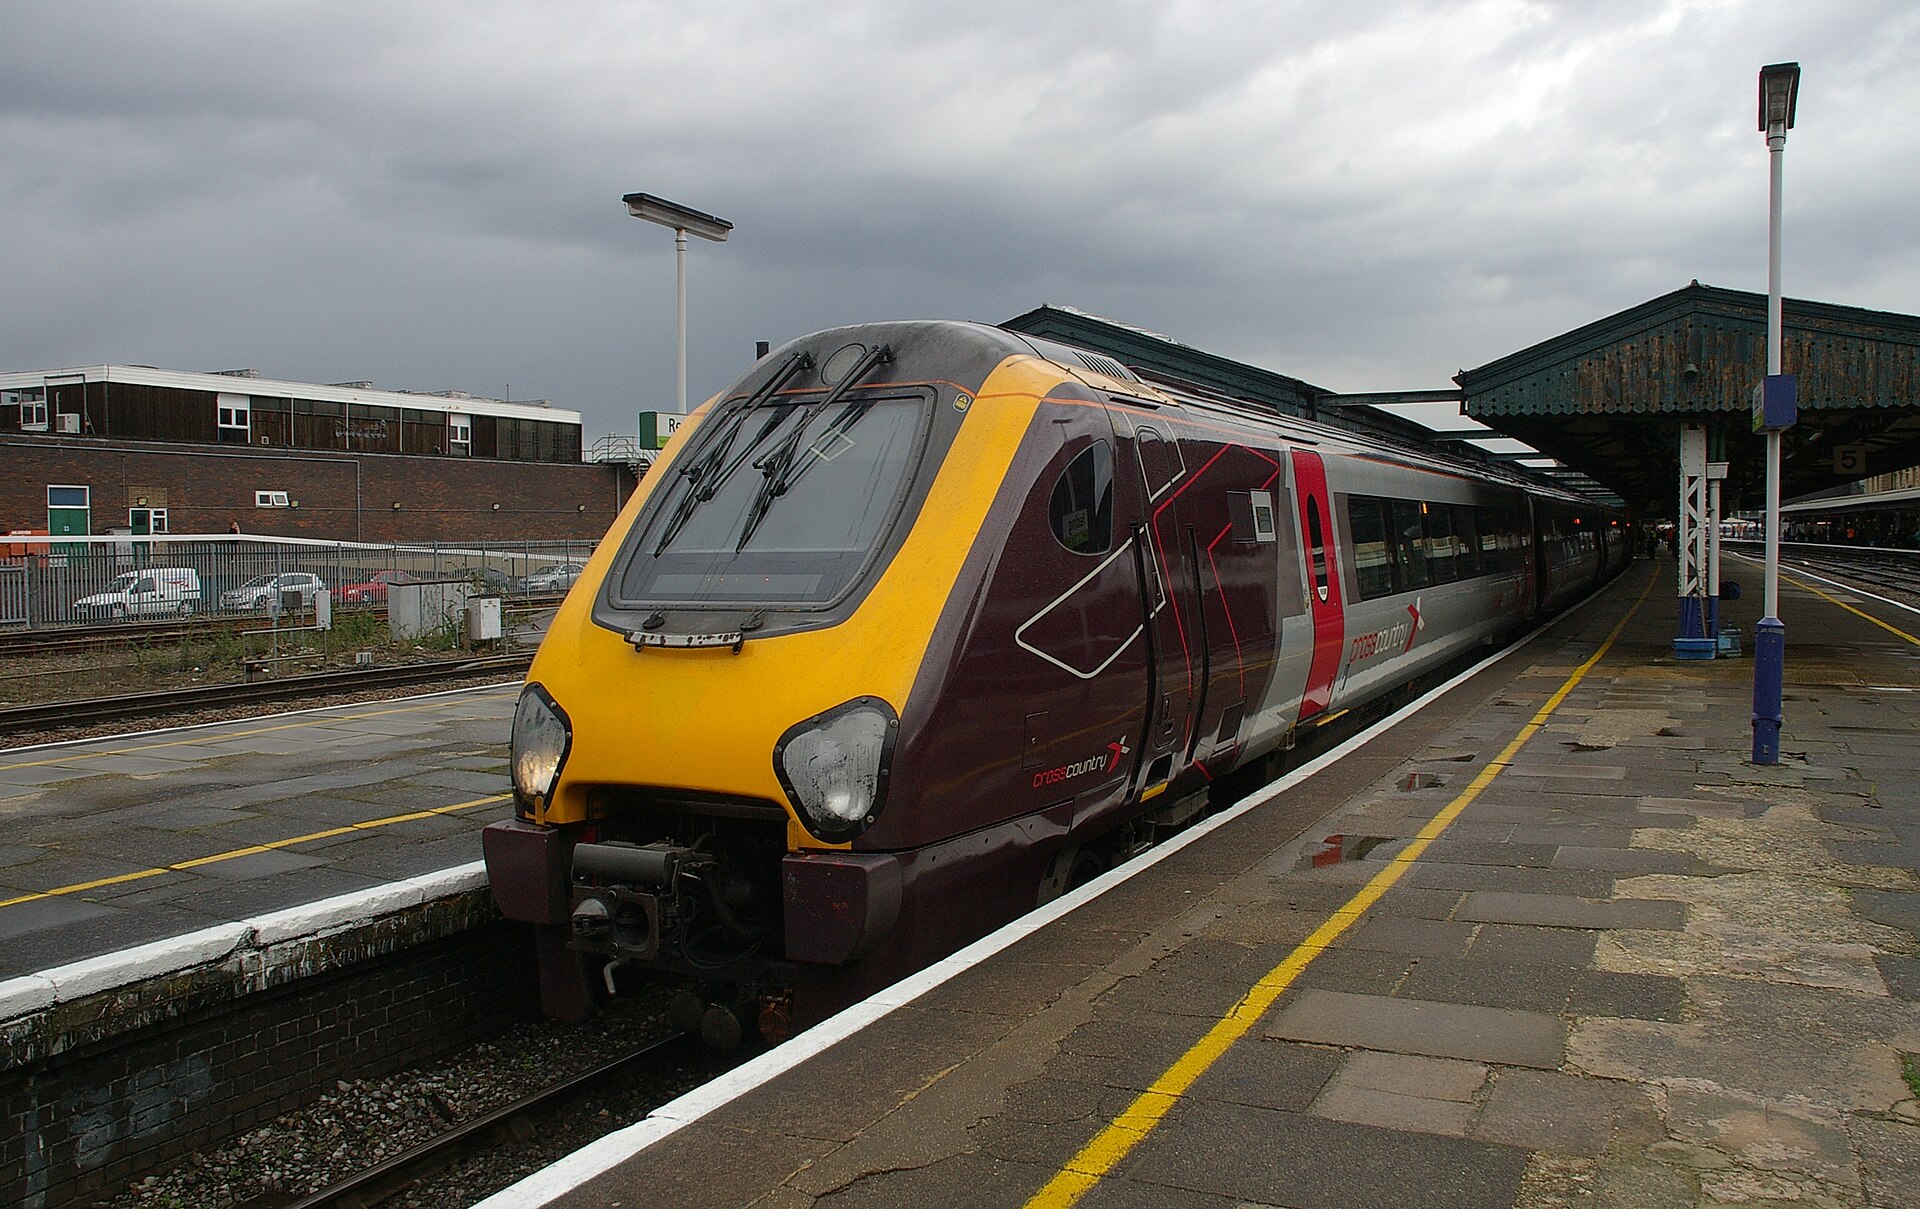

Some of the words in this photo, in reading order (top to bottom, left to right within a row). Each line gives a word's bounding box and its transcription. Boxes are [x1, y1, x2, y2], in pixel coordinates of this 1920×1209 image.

[1841, 450, 1857, 469] 5
[1348, 621, 1409, 663] crosscountry
[1033, 753, 1108, 788] crosscountry
